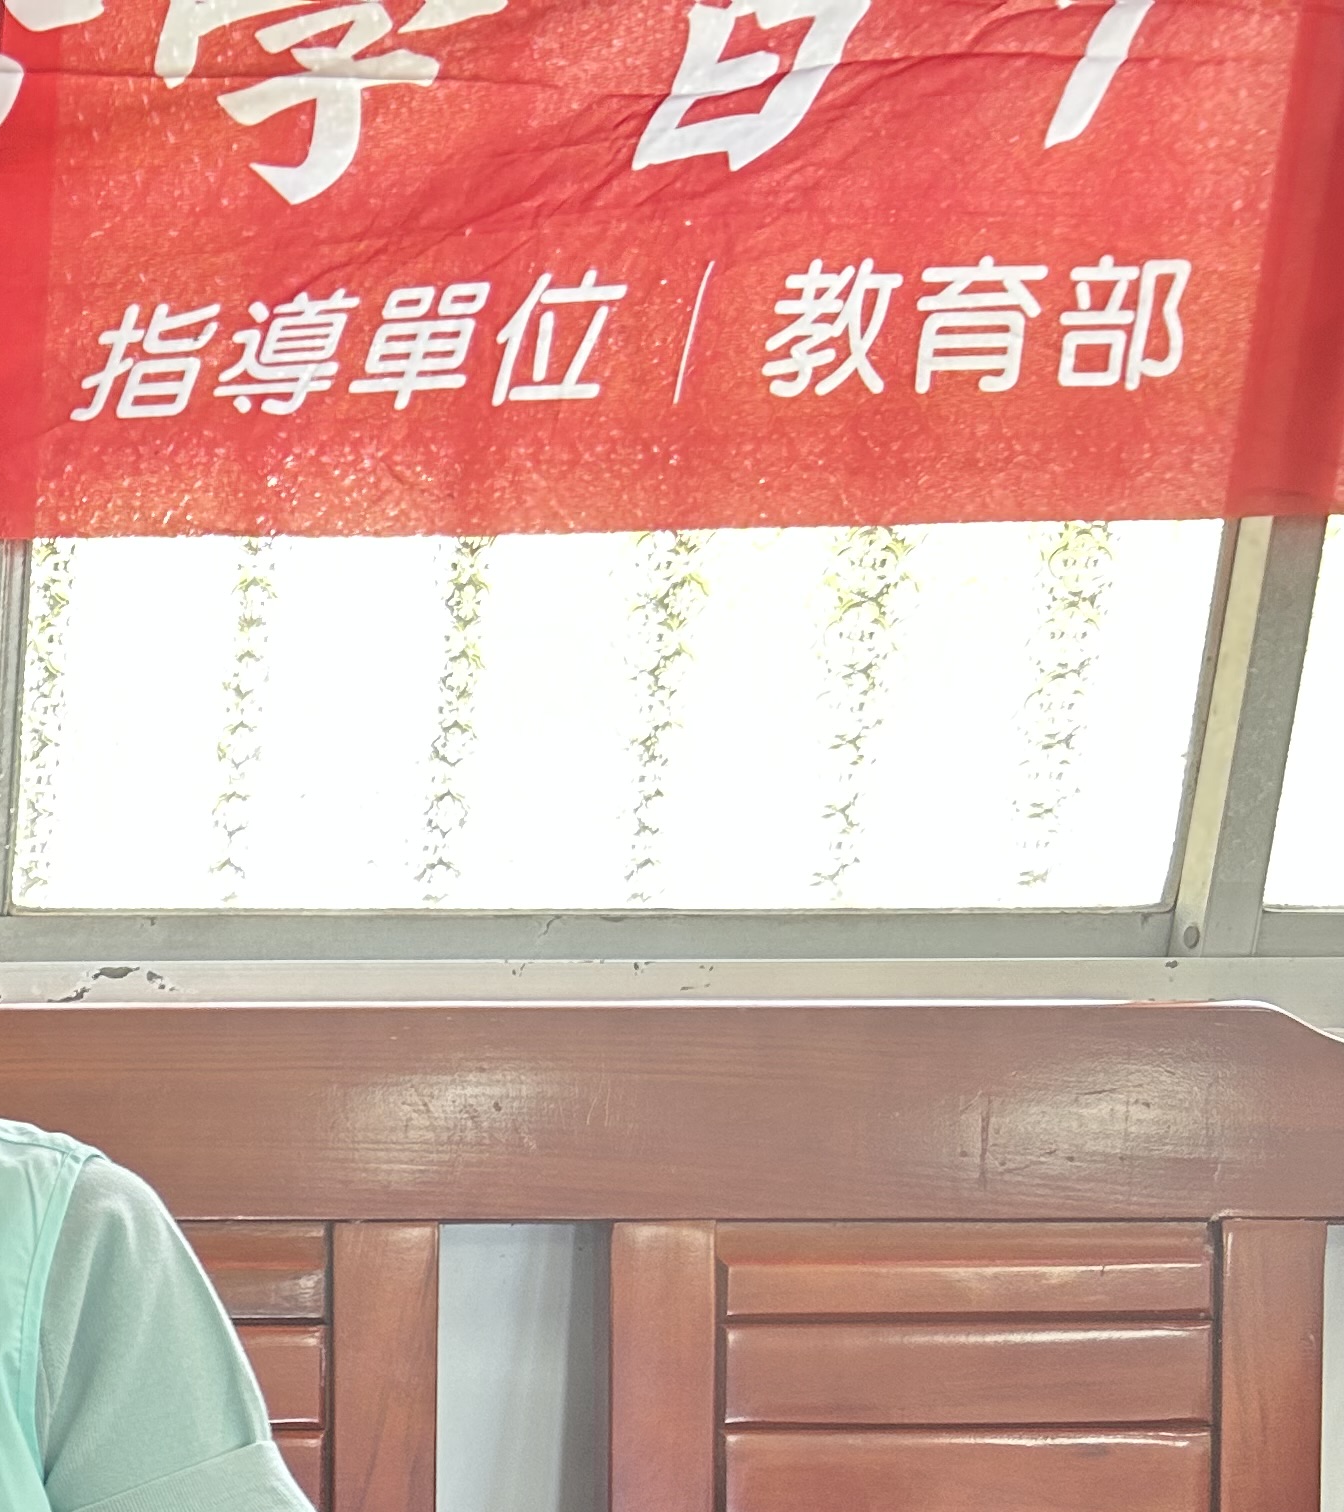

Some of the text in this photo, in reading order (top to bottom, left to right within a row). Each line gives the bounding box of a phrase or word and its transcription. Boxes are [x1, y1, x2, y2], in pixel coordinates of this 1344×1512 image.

[70, 254, 1193, 422] 指導單位 教育部
